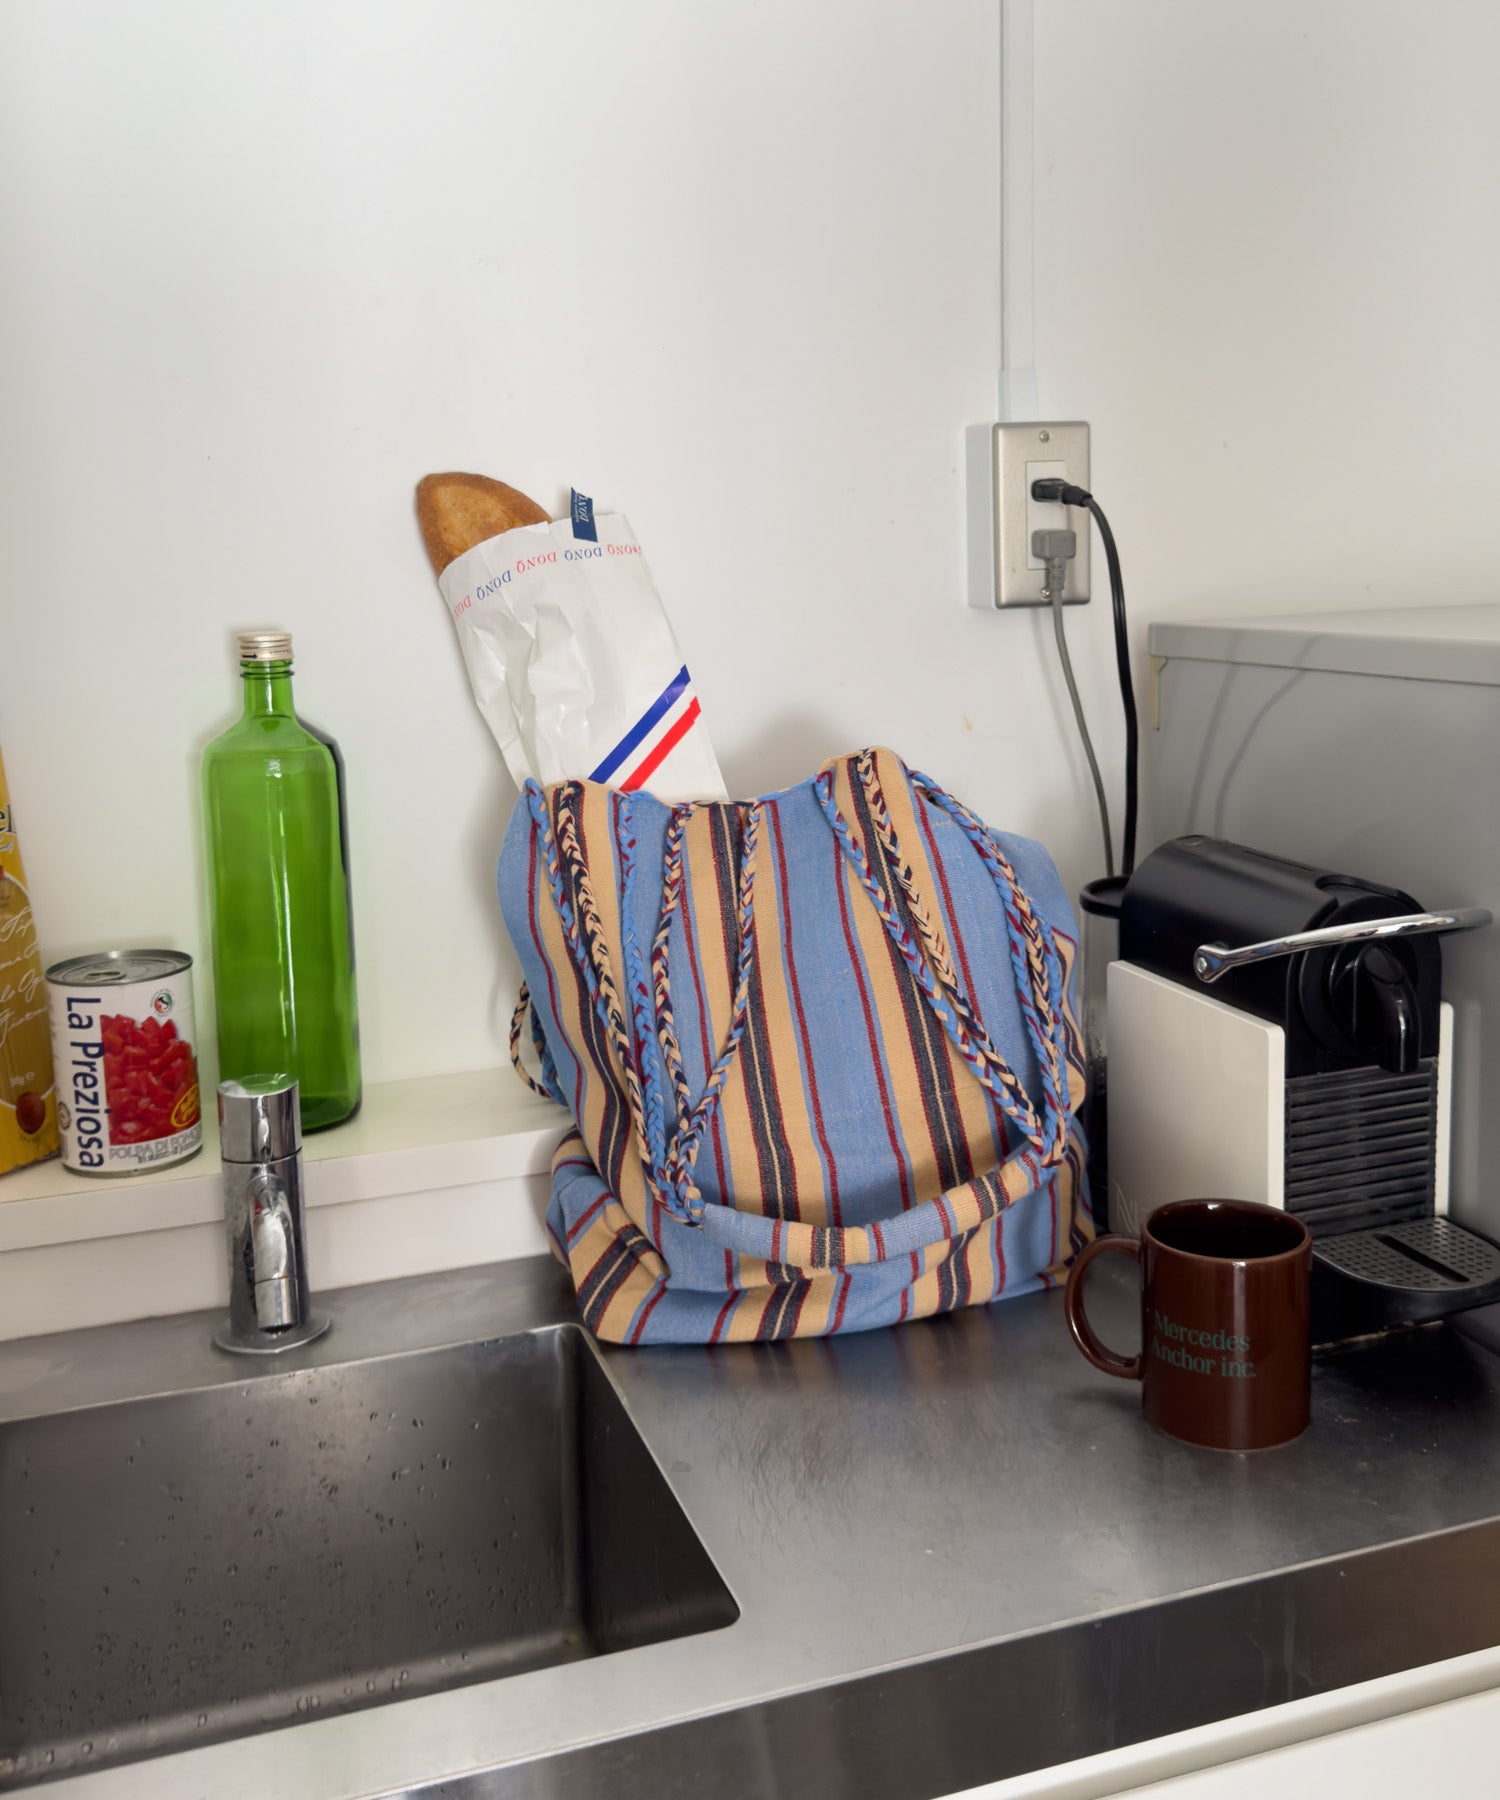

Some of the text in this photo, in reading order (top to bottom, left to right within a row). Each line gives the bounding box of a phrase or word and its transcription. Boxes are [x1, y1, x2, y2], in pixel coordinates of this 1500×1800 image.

[516, 552, 557, 574] DONQ
[564, 547, 602, 561] DONQ
[476, 570, 512, 600] DONQ
[66, 996, 102, 1030] La
[1155, 1310, 1250, 1352] Mercedes
[1152, 1336, 1257, 1378] Anchor inc.
